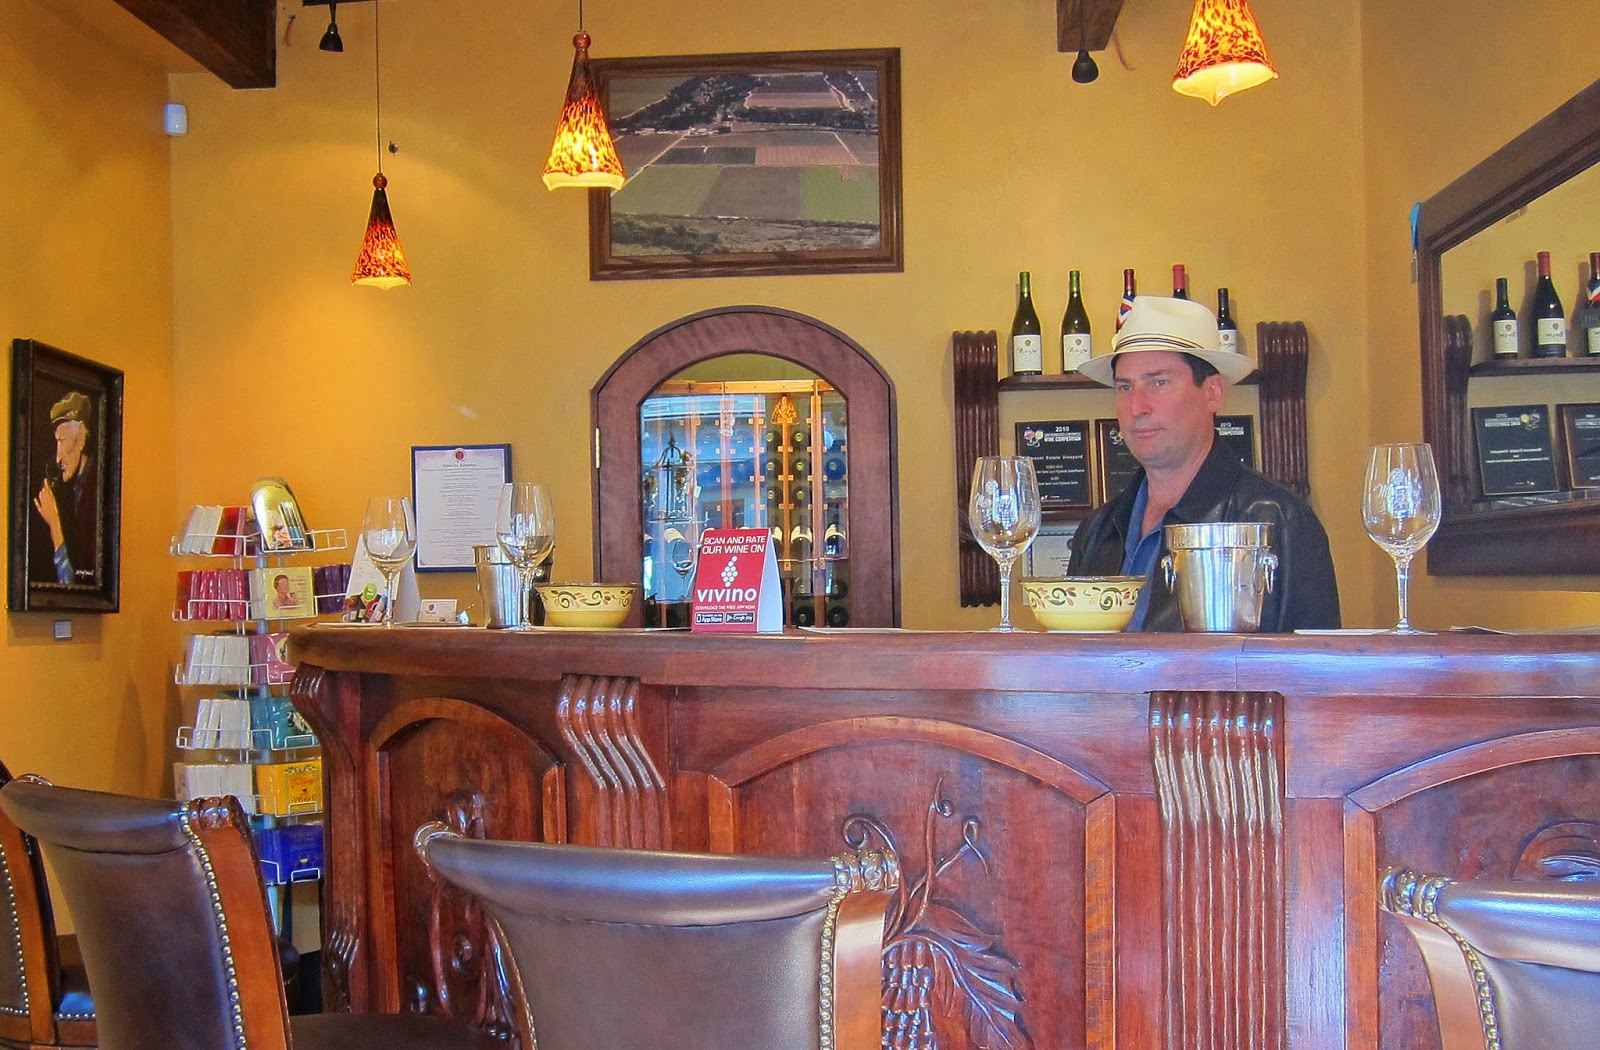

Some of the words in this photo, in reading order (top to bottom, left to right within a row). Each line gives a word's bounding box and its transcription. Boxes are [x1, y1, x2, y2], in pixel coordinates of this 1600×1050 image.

[704, 537, 726, 545] SCAN
[726, 536, 745, 544] AND
[745, 535, 766, 543] RATE
[702, 545, 722, 555] OUR
[724, 544, 749, 554] WINE
[750, 544, 765, 553] ON
[696, 588, 757, 603] vivino
